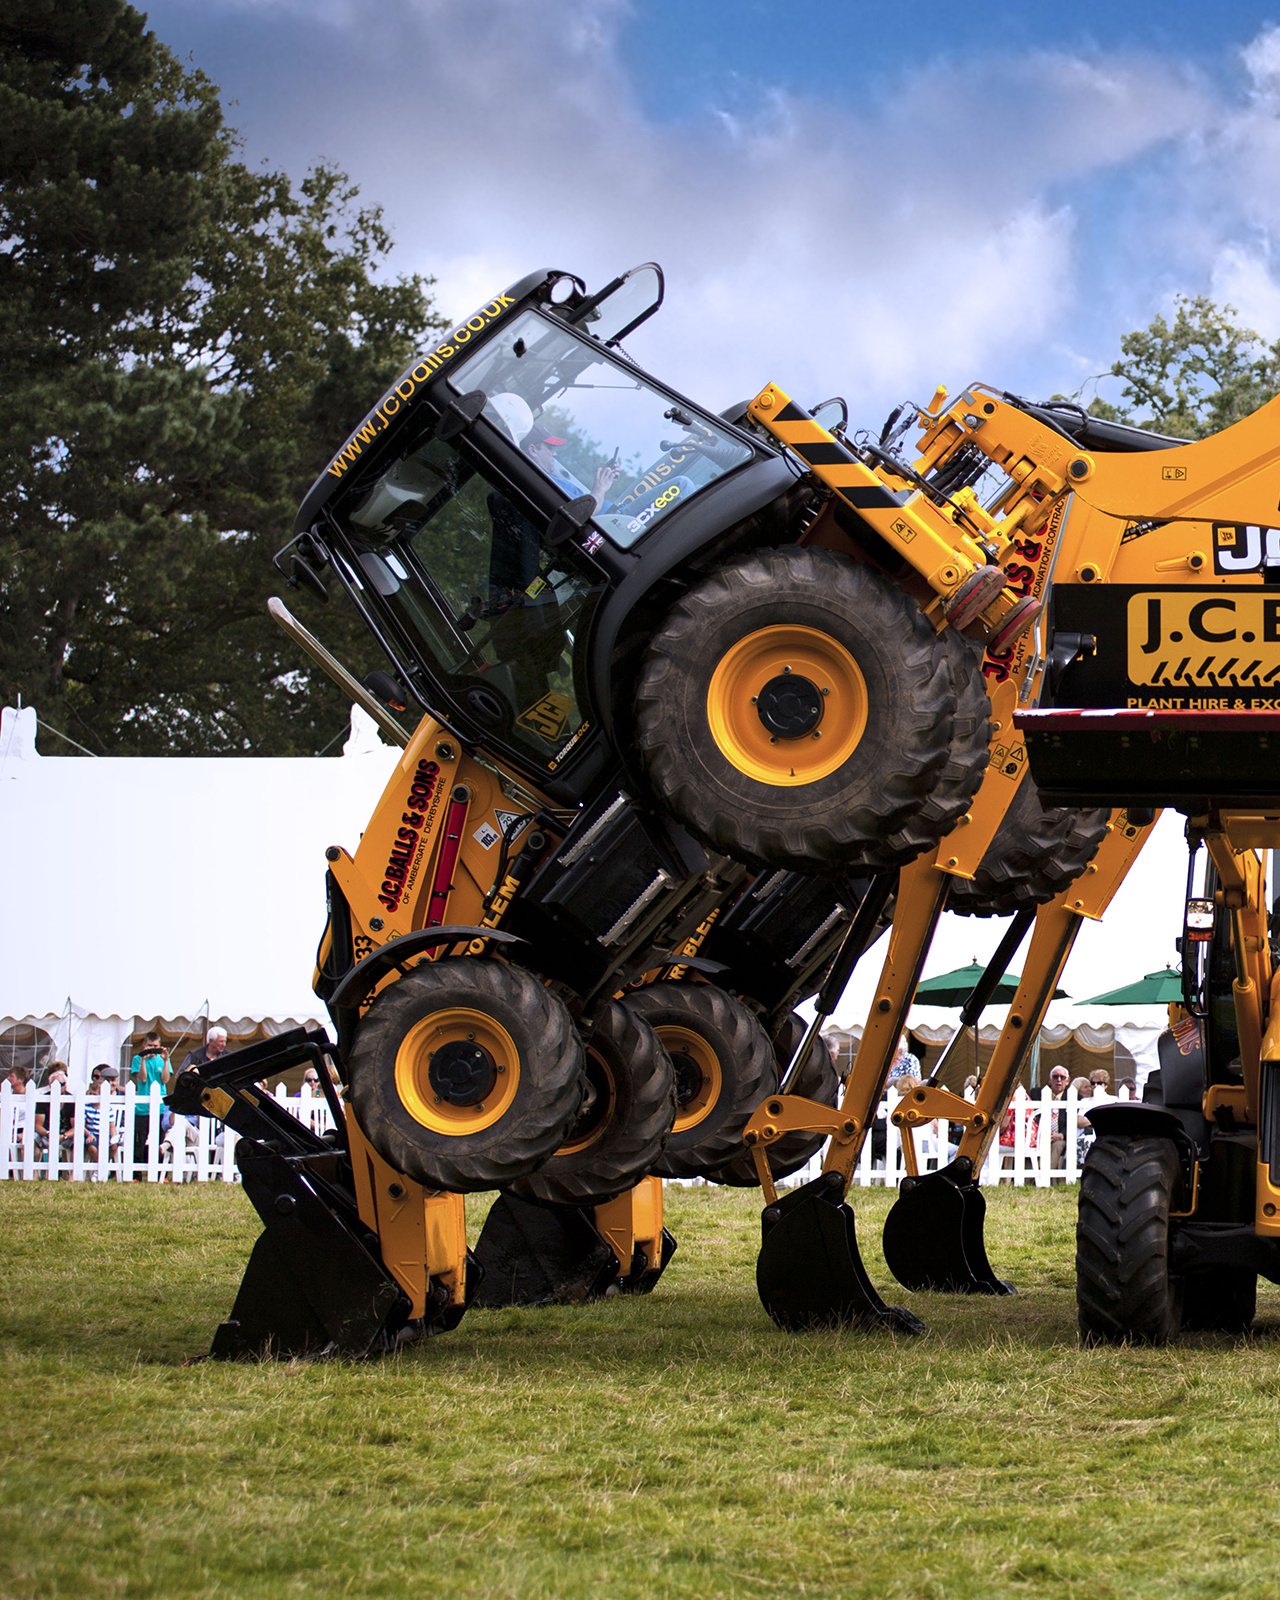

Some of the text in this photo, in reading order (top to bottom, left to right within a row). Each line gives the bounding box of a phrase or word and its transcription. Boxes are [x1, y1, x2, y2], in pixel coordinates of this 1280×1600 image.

[328, 292, 515, 478] www.jcballs.co.uk
[627, 485, 681, 533] 3CXeco
[1013, 640, 1027, 674] PLANT
[1032, 546, 1051, 600] XCAVATION
[1127, 698, 1185, 710] PLANT
[1188, 698, 1230, 710] HIRE
[1233, 698, 1247, 710] &
[407, 758, 441, 813] SONS
[401, 811, 427, 830] &
[402, 777, 447, 905] OF AMBERGATE DERBYSHIRE
[481, 833, 495, 848] 103
